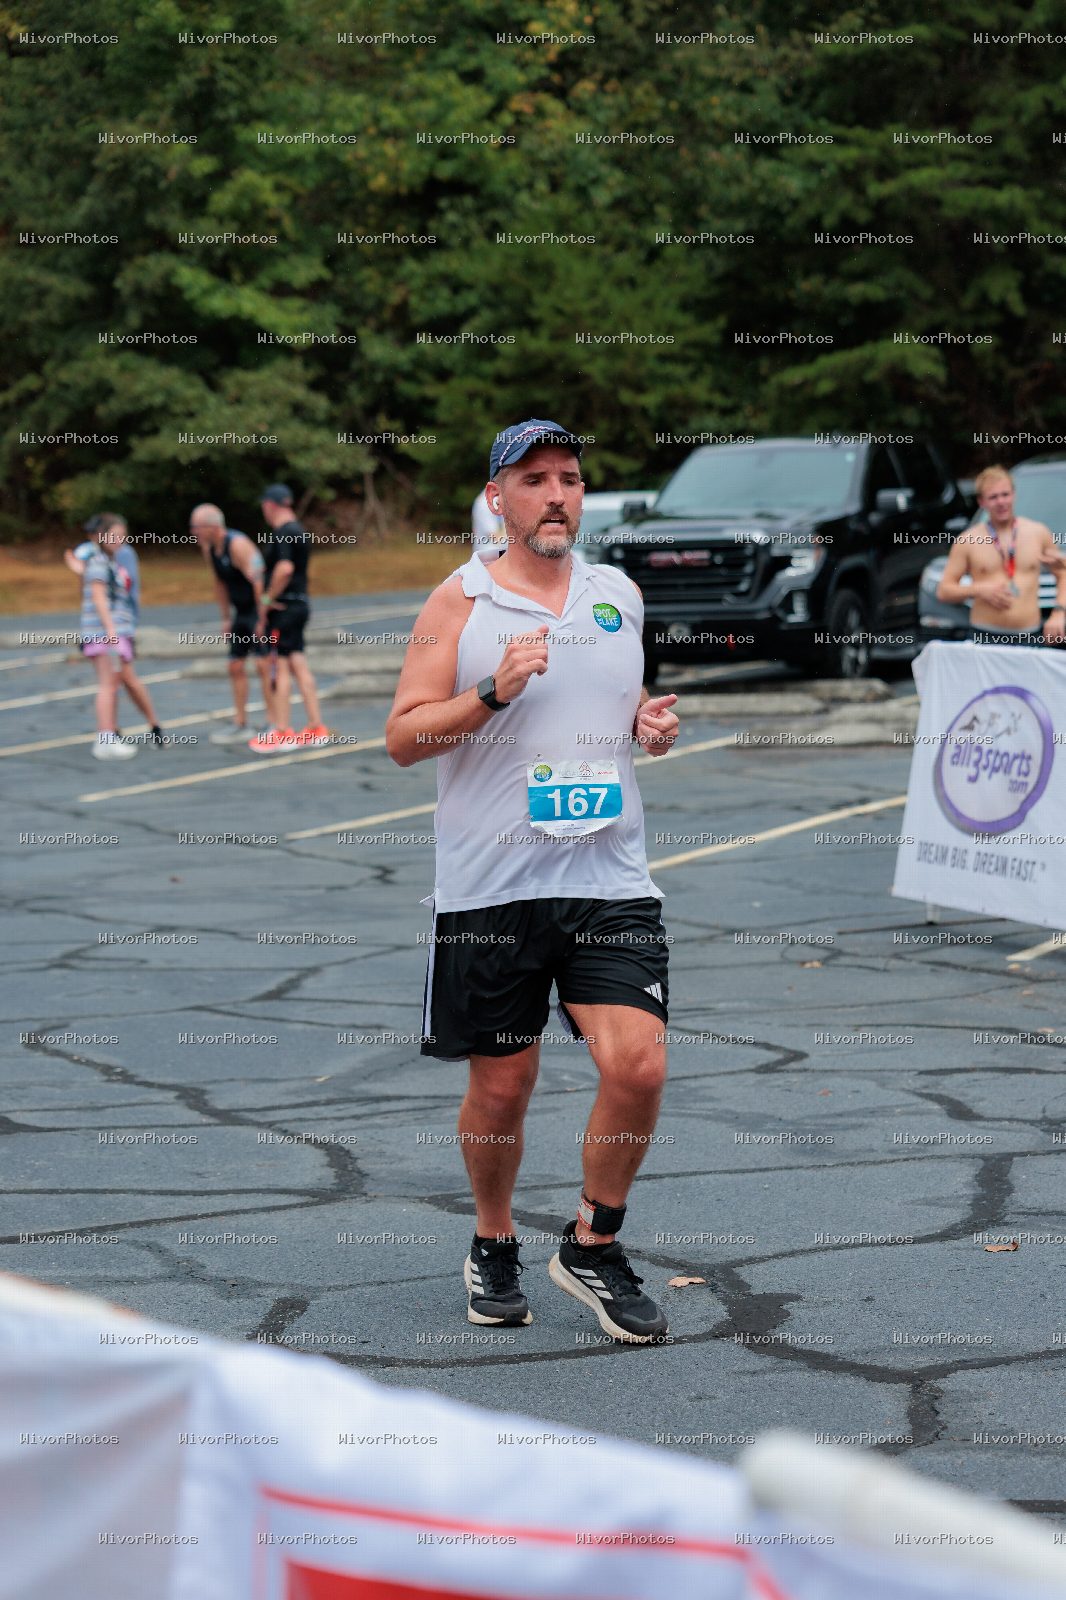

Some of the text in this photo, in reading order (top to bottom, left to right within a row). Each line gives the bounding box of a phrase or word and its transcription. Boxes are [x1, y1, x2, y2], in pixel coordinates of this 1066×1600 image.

[951, 744, 1032, 783] all3sports
[547, 787, 608, 817] 167
[916, 840, 949, 867] DREAM
[972, 850, 1009, 879] DREAM
